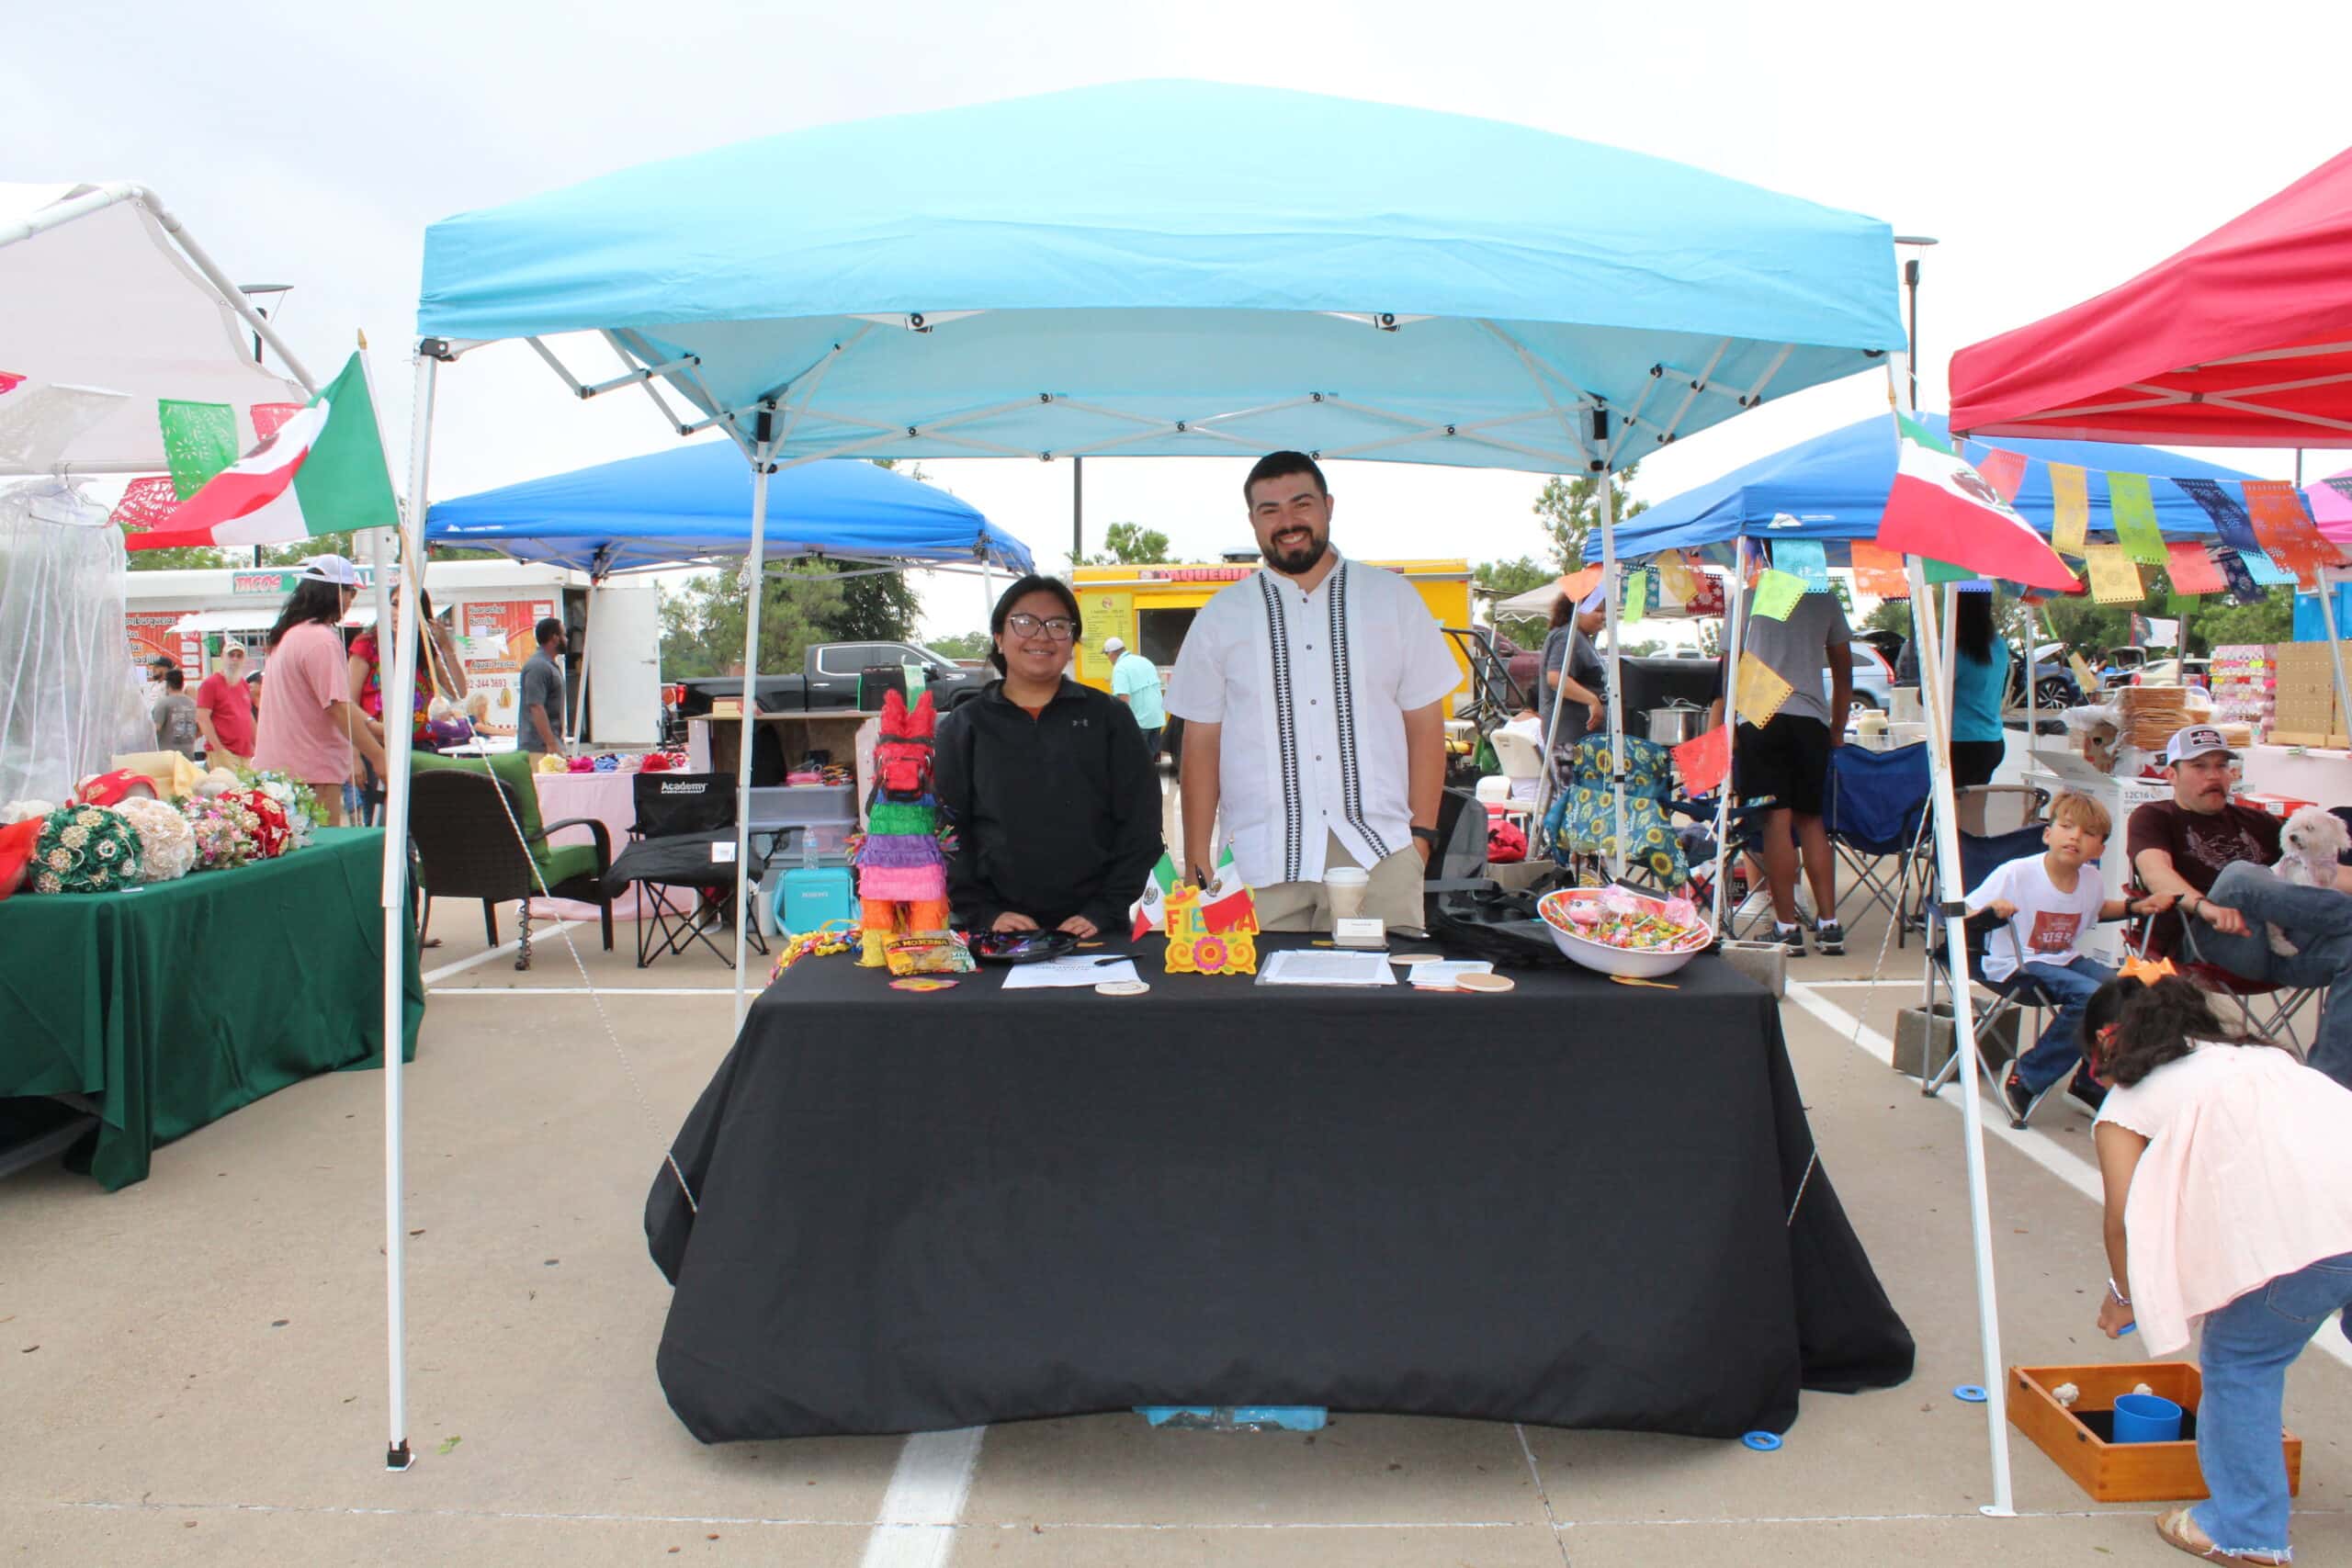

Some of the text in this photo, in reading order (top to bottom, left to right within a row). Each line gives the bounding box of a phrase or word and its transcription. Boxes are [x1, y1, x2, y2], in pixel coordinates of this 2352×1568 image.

[234, 575, 281, 592] TACOS
[662, 782, 707, 793] Academy
[1166, 908, 1258, 935] FIEA
